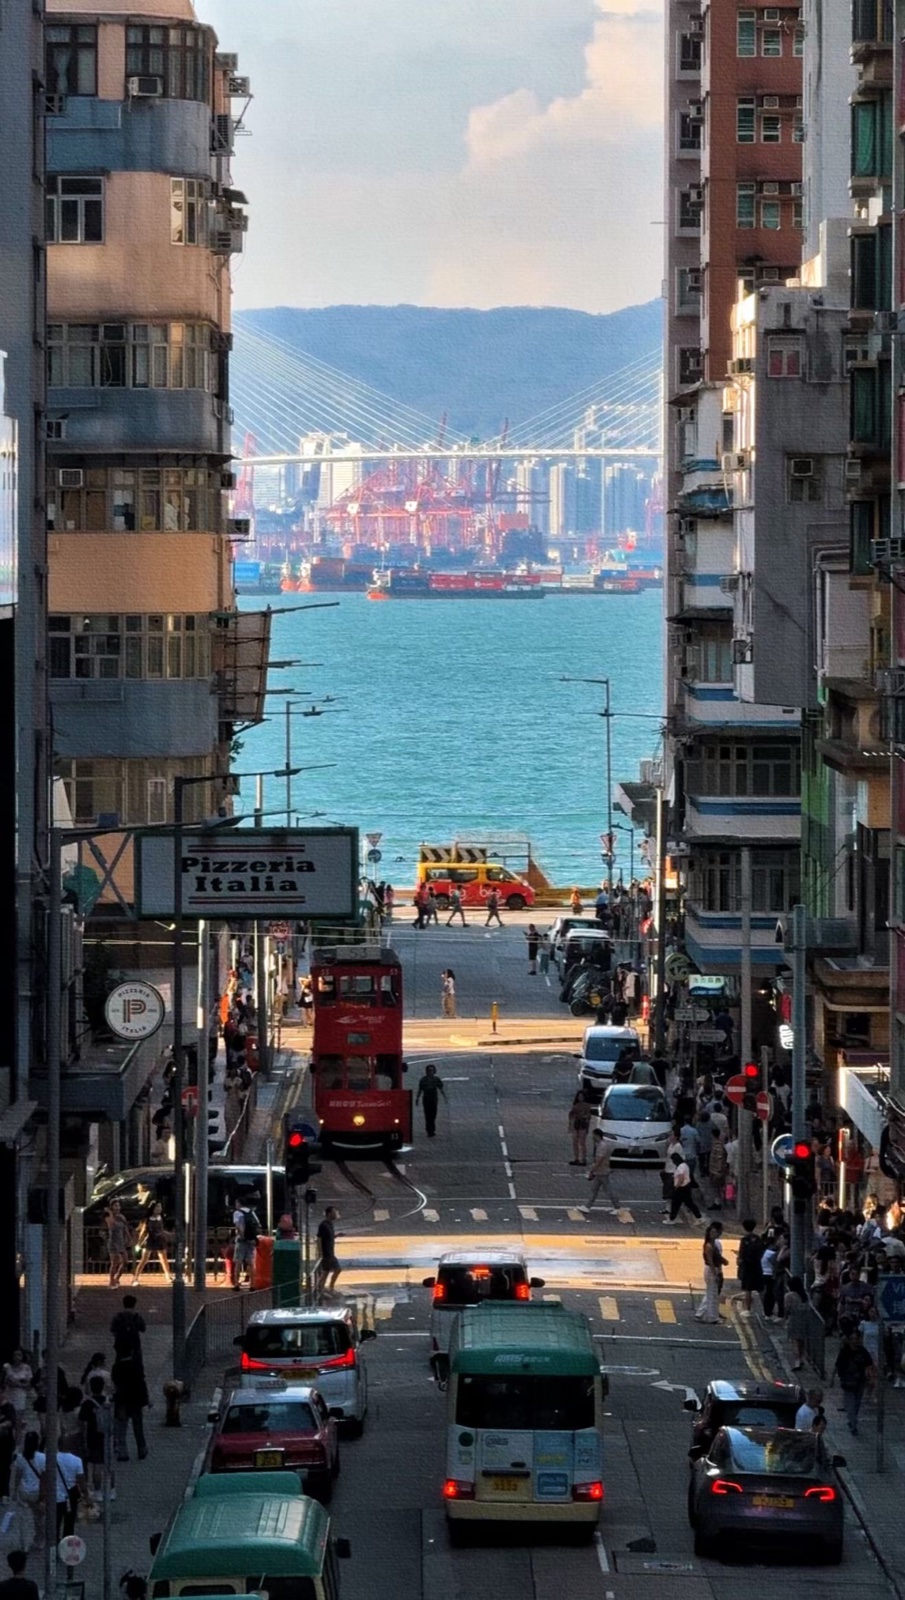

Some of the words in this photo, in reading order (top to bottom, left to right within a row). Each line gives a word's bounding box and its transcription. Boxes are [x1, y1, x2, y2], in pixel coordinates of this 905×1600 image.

[181, 856, 316, 873] Pizzeria
[195, 876, 298, 892] Italia
[122, 1026, 147, 1034] ITALIA
